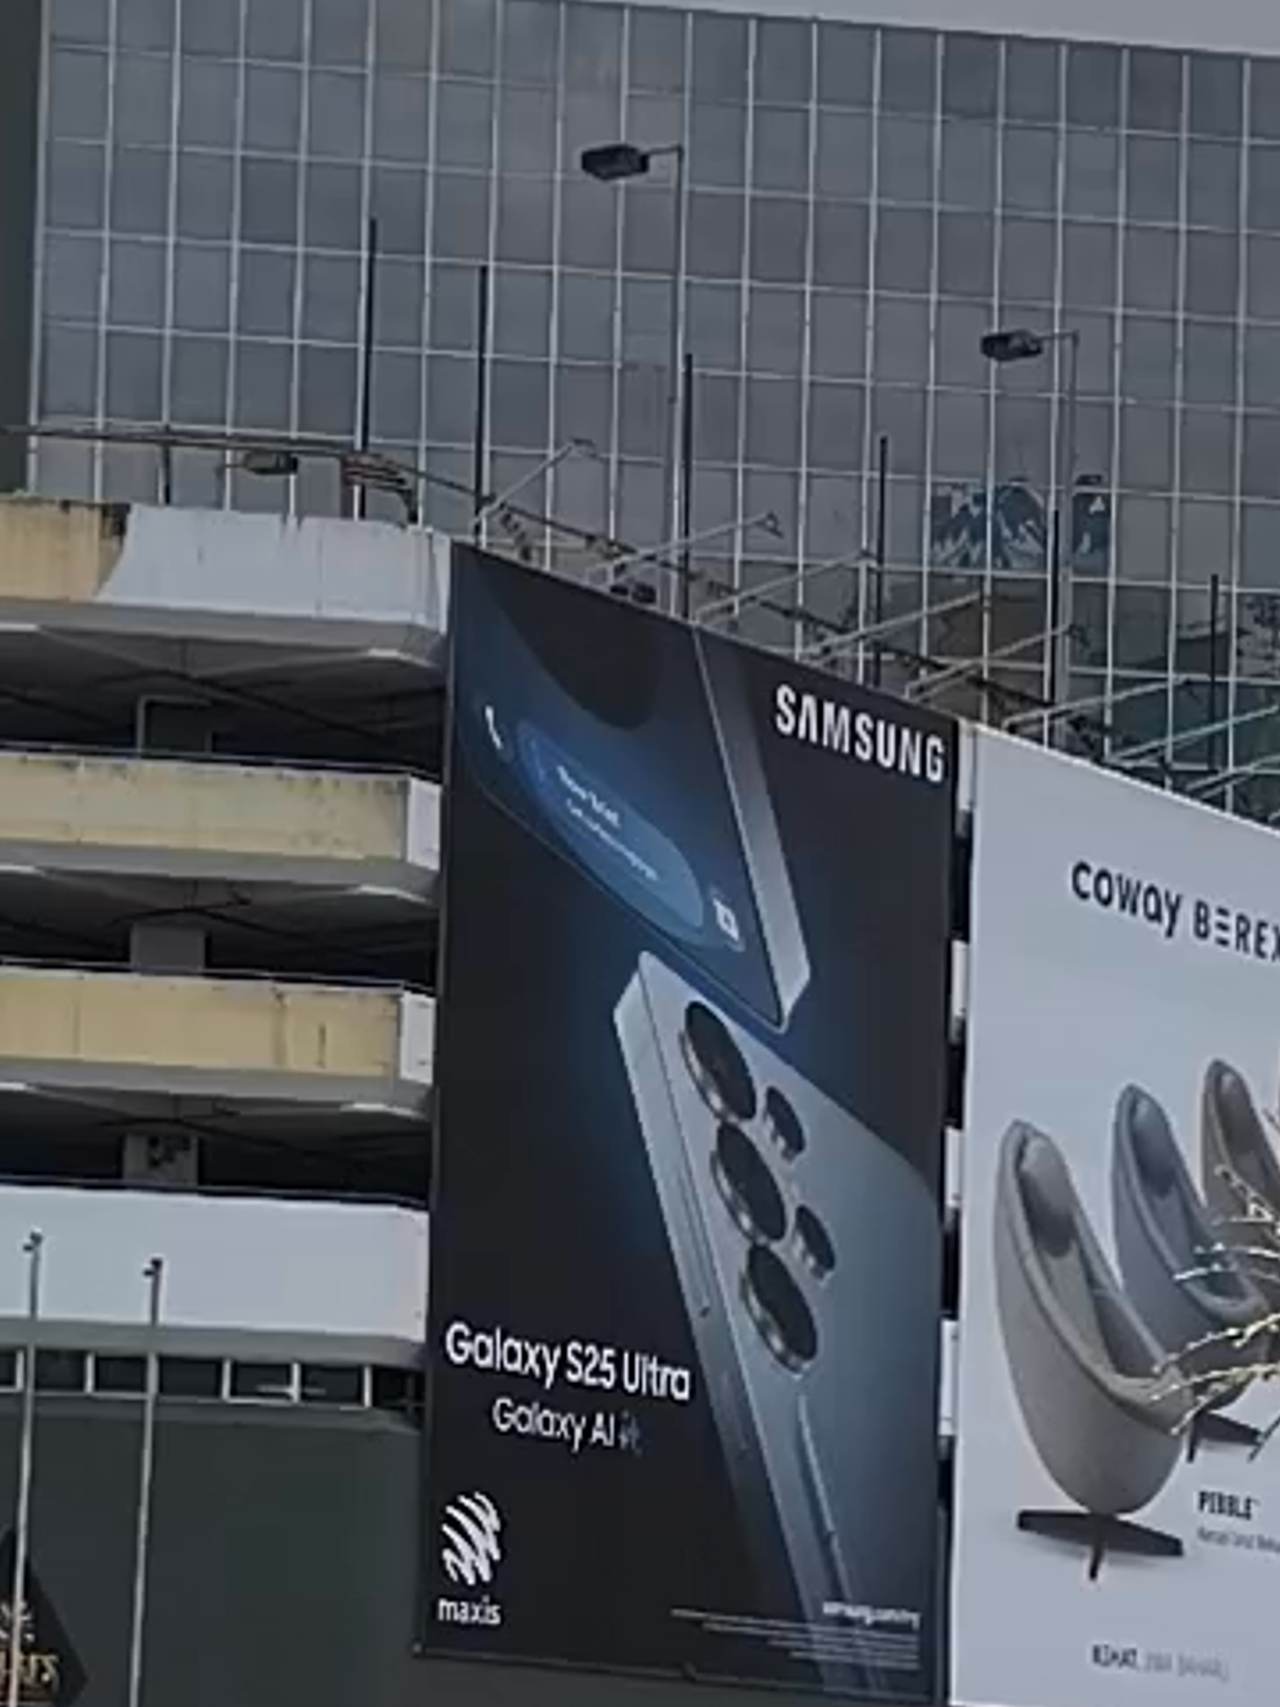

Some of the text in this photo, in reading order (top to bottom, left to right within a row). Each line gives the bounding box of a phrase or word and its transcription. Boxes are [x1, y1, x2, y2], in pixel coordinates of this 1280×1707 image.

[776, 683, 945, 783] SAMSUNG
[446, 1322, 691, 1401] Galaxy S25 Ultra
[492, 1397, 616, 1454] Galaxy AI
[438, 1595, 502, 1626] maxis
